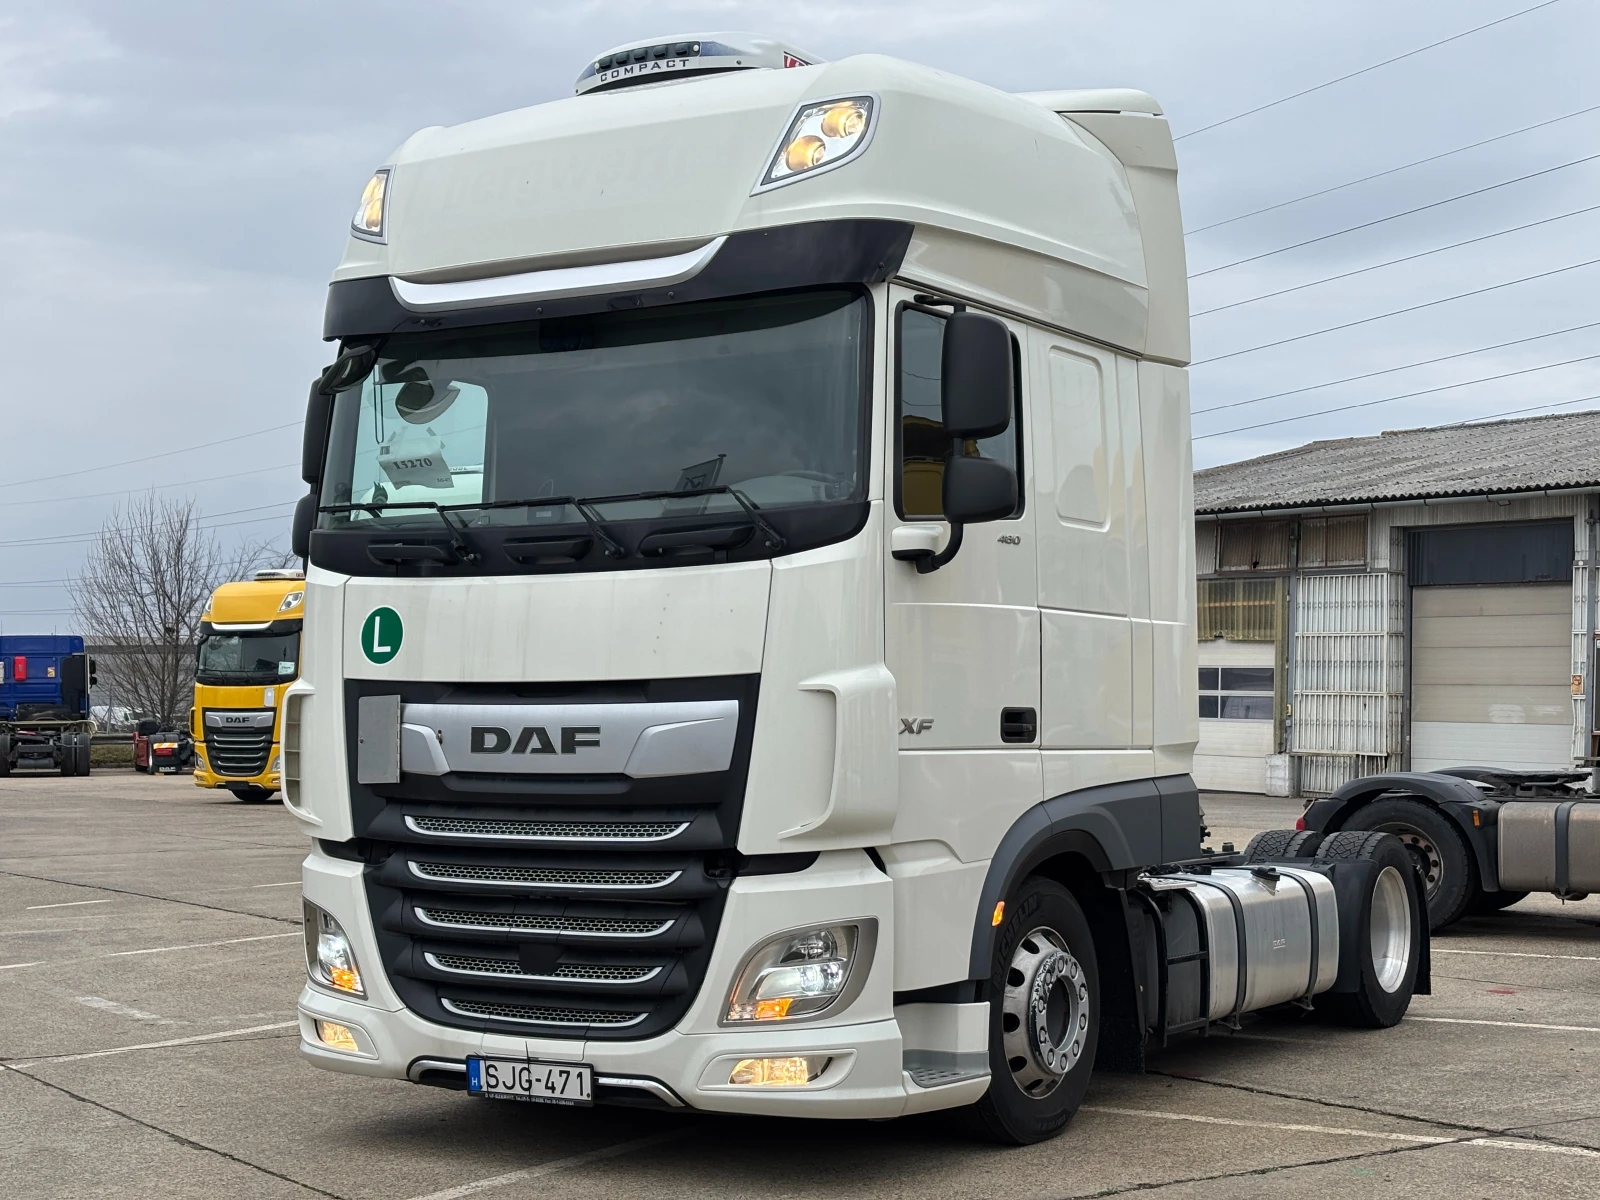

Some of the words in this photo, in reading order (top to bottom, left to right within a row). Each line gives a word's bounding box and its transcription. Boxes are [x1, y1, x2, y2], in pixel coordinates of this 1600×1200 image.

[600, 58, 690, 82] COMPACT
[373, 616, 391, 653] L
[226, 716, 250, 724] DAF
[899, 718, 934, 734] XF
[470, 725, 601, 755] DAF
[471, 1077, 478, 1086] H
[486, 1063, 584, 1097] SJG-471
